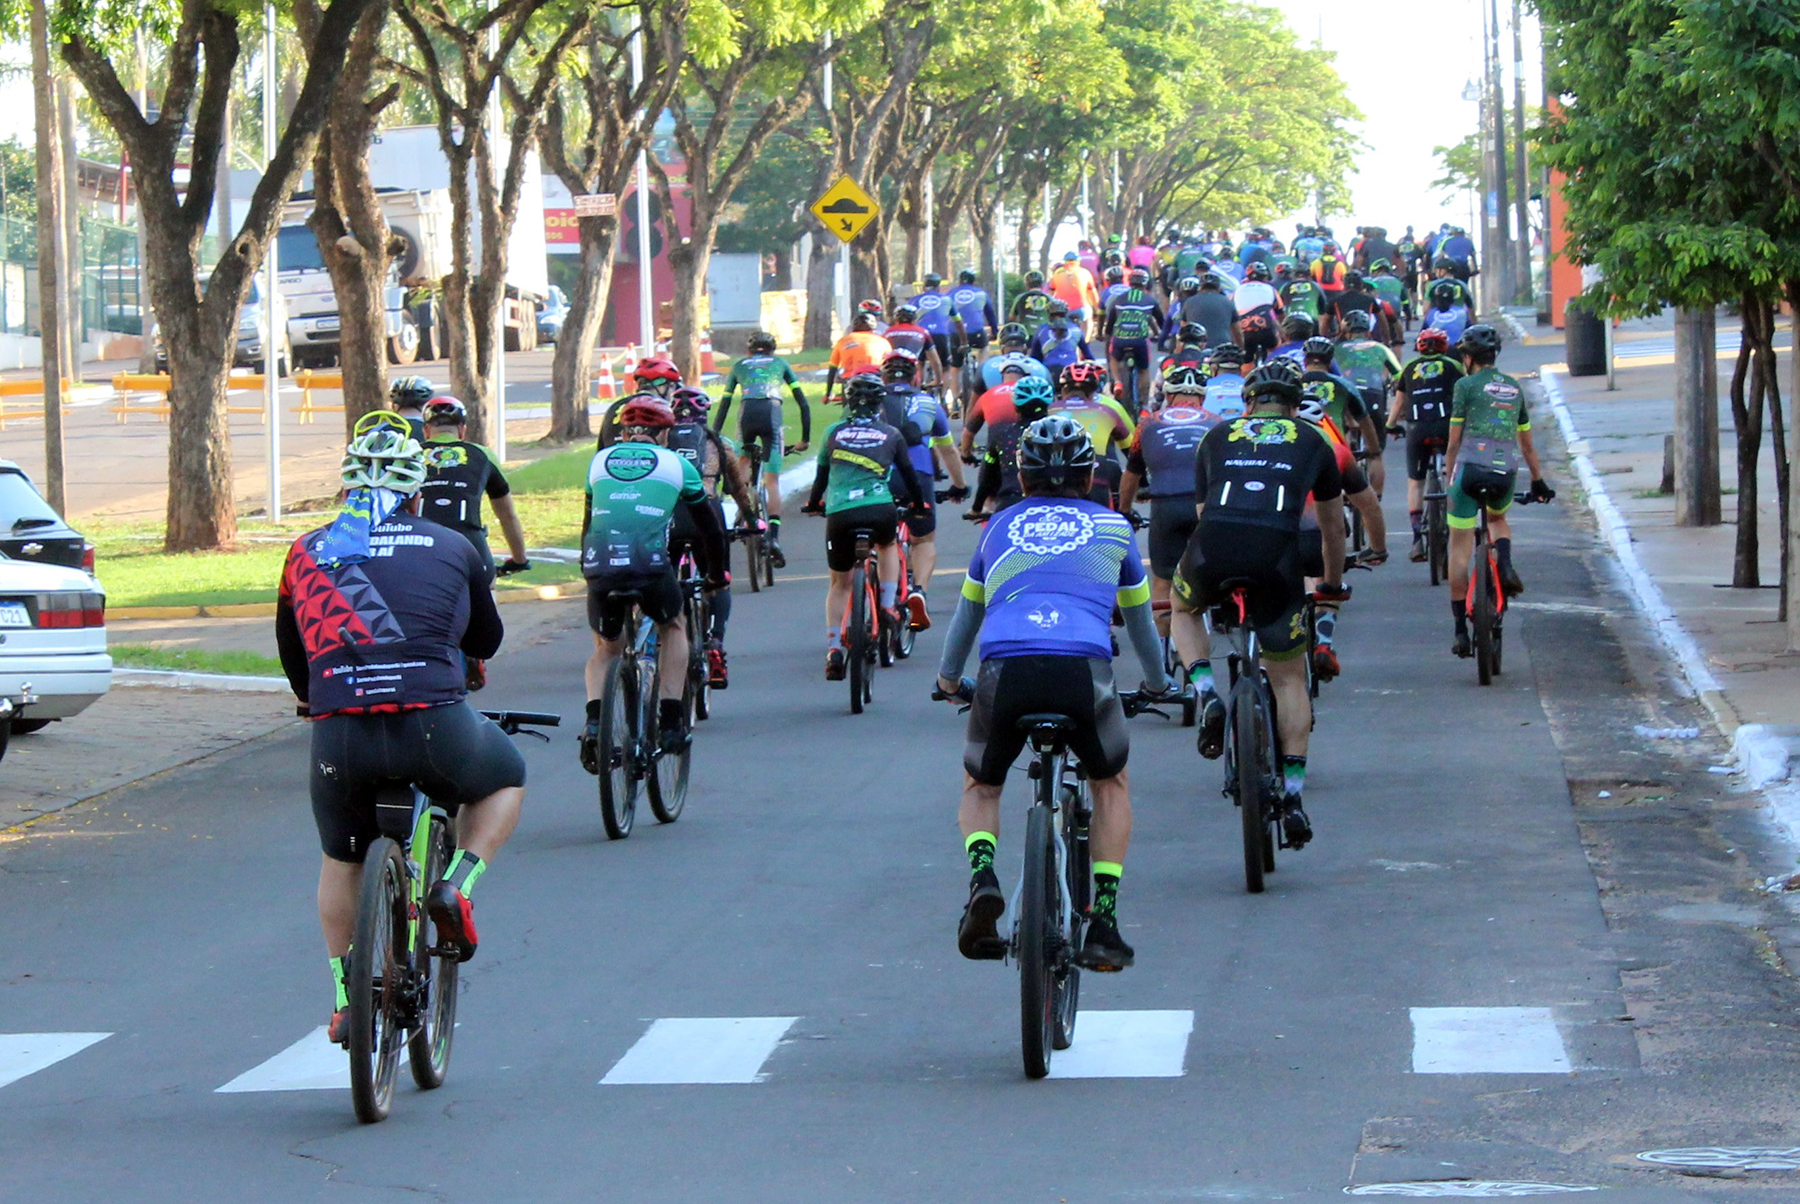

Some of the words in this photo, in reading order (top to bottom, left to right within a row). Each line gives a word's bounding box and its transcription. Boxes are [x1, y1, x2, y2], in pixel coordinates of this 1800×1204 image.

[371, 522, 413, 533] ouTube
[1024, 521, 1079, 535] PEDAL
[369, 534, 435, 547] DALANDO
